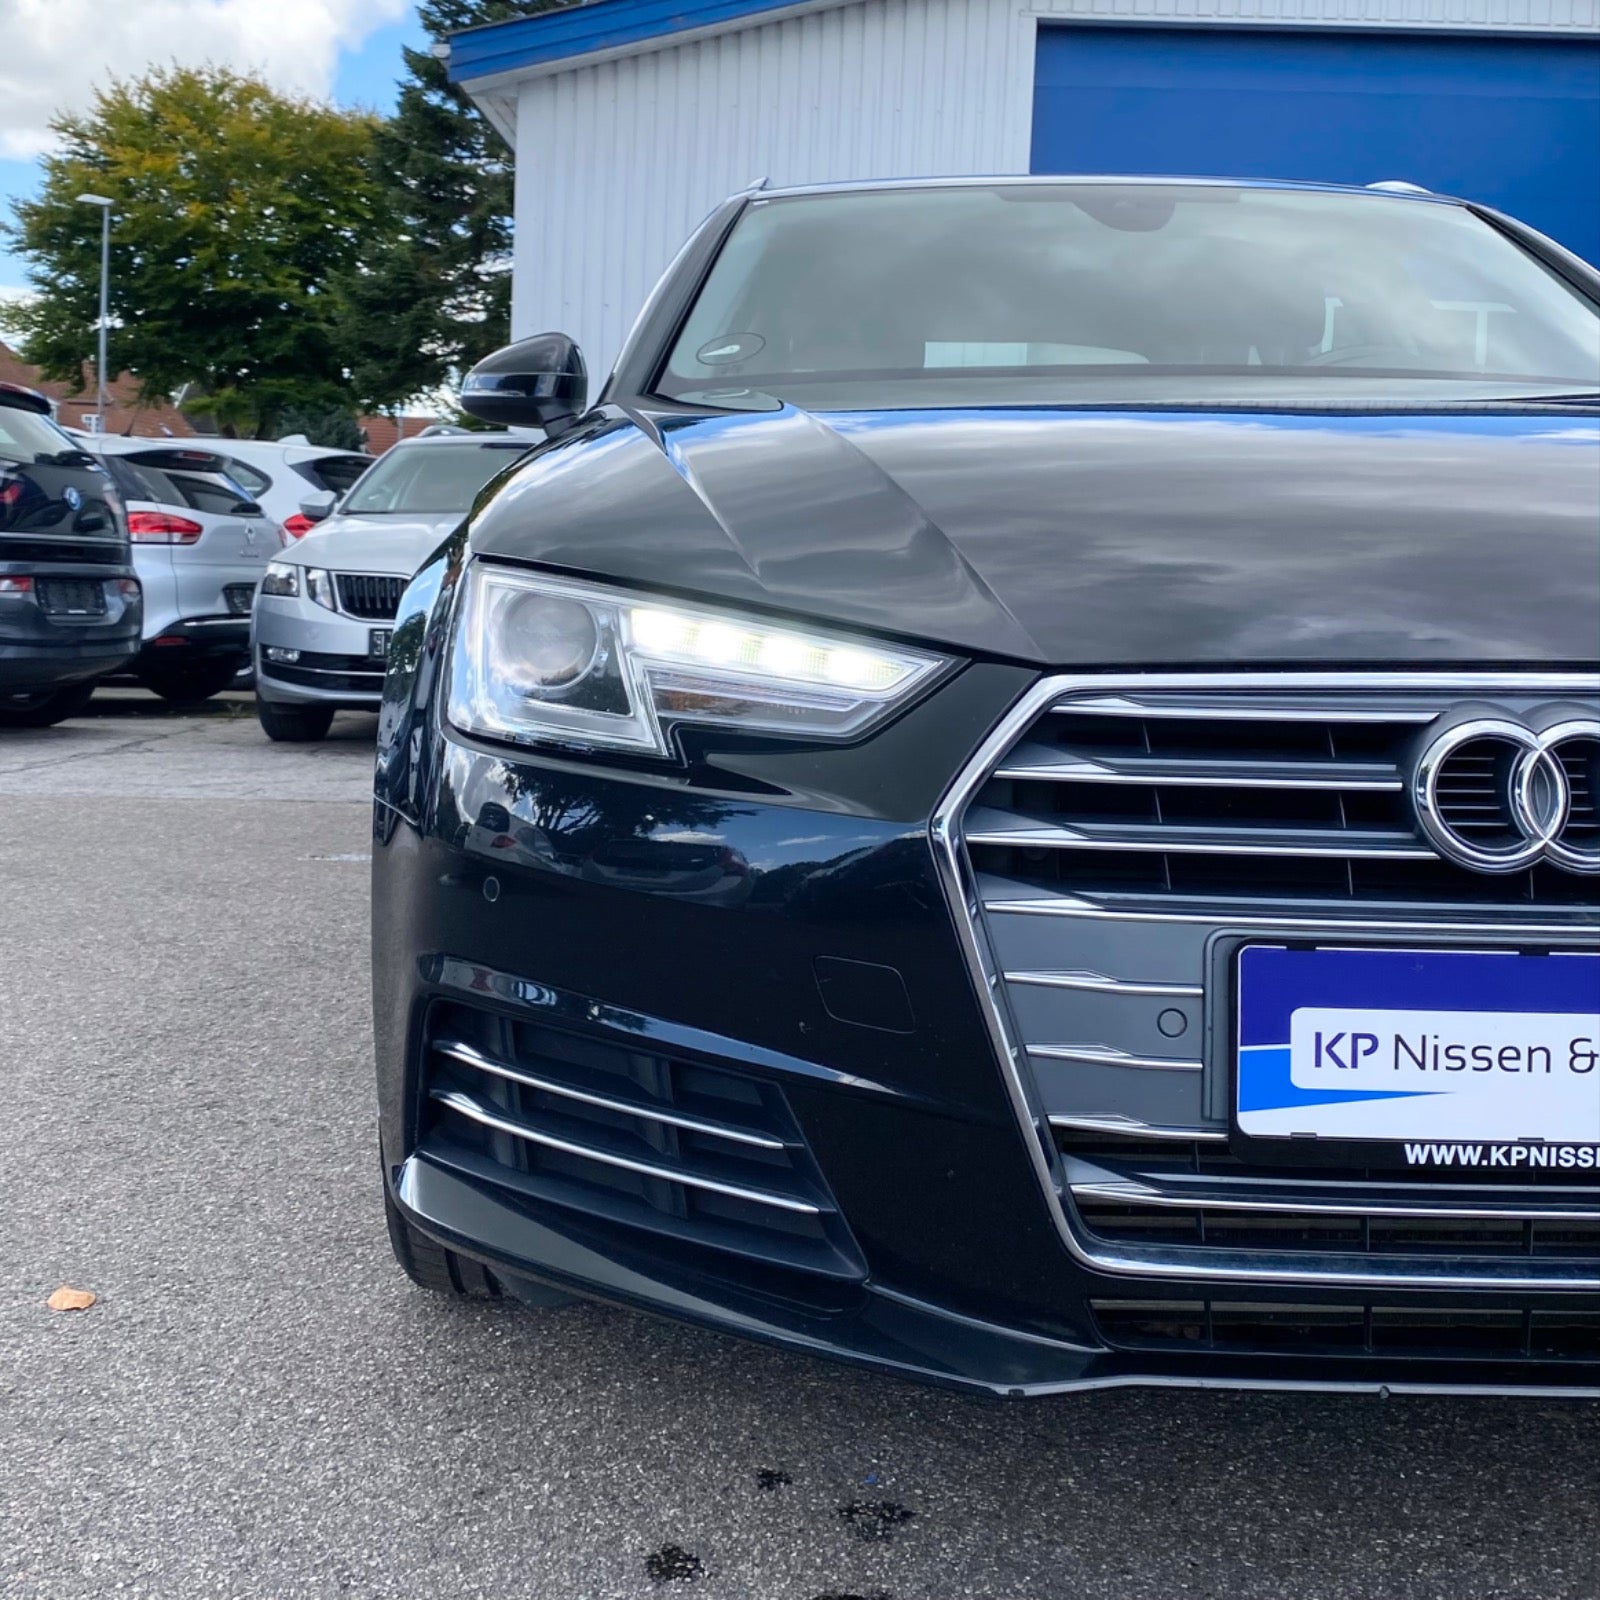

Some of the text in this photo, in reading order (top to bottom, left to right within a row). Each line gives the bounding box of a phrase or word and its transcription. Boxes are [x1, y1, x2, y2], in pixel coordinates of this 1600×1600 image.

[1314, 1031, 1600, 1074] KP Nissen &
[1404, 1143, 1600, 1168] WWW.KPNISS
